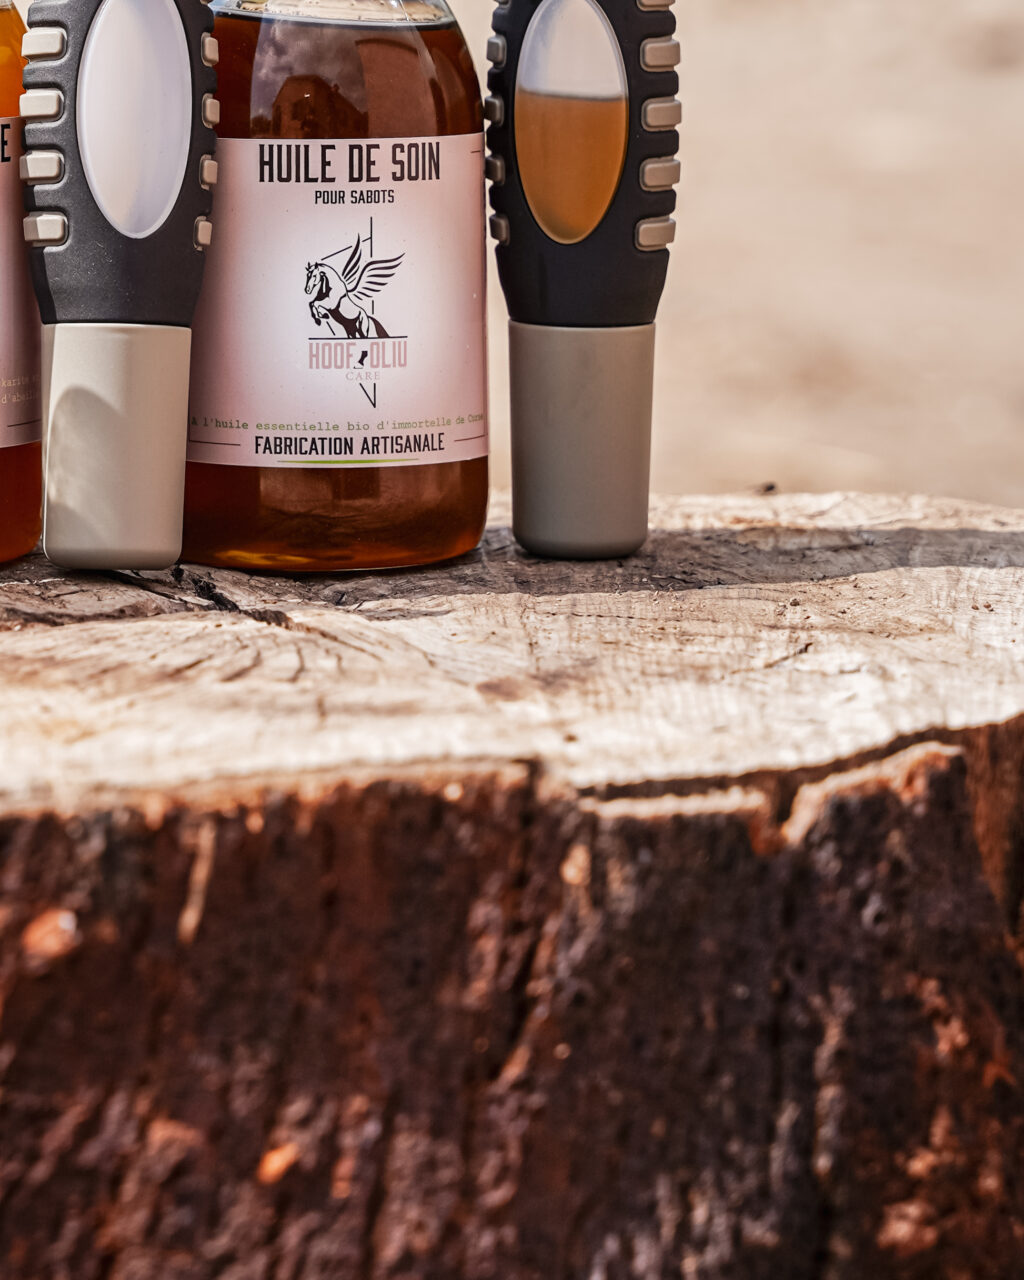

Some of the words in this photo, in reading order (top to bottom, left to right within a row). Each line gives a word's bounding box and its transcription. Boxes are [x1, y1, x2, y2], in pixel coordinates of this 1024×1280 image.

[258, 144, 337, 184] HUILE
[348, 143, 381, 183] DE
[391, 141, 441, 182] SOIN
[314, 190, 346, 205] POUR
[350, 189, 396, 205] SABOTS
[308, 341, 357, 370] HOOF
[345, 370, 382, 382] CARE
[202, 417, 250, 431] l'huile
[255, 420, 341, 432] essentielle
[346, 420, 370, 432] bio
[376, 417, 452, 431] d'immortelle
[254, 435, 354, 456] FABRICATION
[360, 432, 446, 456] ARTISANALE
